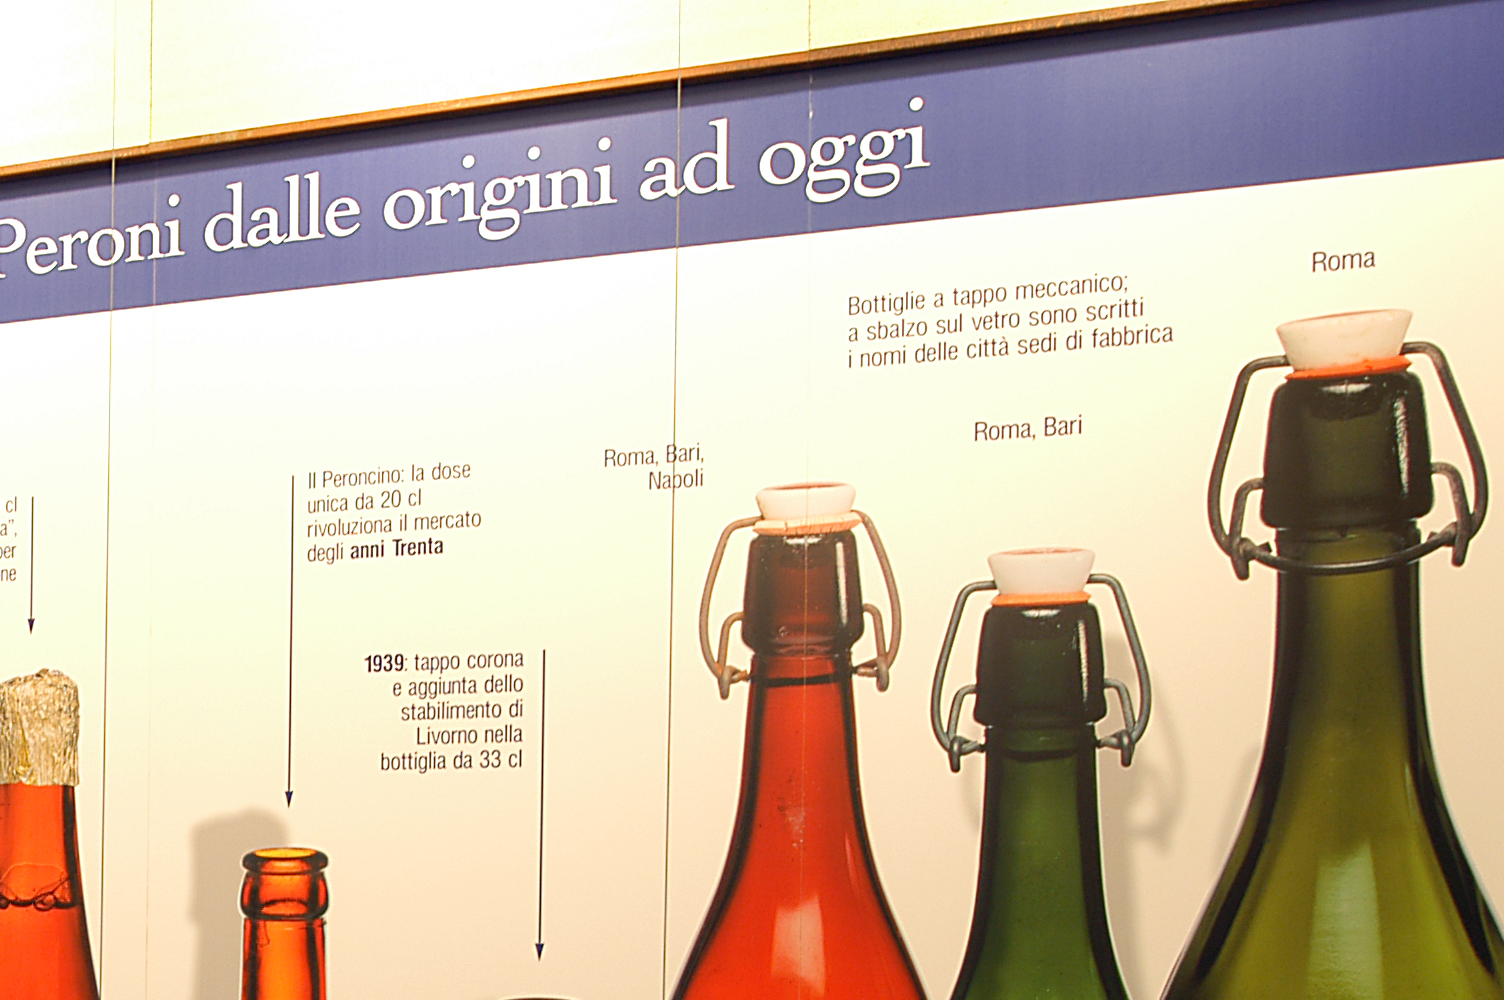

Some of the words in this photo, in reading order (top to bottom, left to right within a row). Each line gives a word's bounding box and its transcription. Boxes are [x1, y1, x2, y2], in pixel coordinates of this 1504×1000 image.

[204, 174, 361, 253] dalle
[383, 137, 617, 240] origini
[640, 118, 733, 200] ad
[759, 97, 930, 203] oggi
[1311, 251, 1376, 273] Roma
[847, 291, 926, 317] Bottiglie
[933, 291, 945, 308] a
[952, 285, 1008, 312] tappo
[1015, 273, 1129, 301] meccanico;
[848, 326, 859, 344] a
[866, 317, 928, 342] sbalzo
[936, 313, 963, 336] sul
[971, 310, 1021, 333] vetro
[1028, 307, 1078, 327] sono
[1085, 297, 1145, 322] scritti
[847, 349, 853, 369] i
[860, 346, 907, 369] nomi
[914, 341, 958, 364] delle
[966, 335, 1010, 360] città
[1017, 332, 1058, 355] sedi
[1065, 331, 1084, 351] di
[1090, 323, 1174, 350] fabbrica
[974, 420, 1036, 442] Roma,
[1044, 414, 1083, 438] Bari
[603, 448, 658, 468] Roma,
[666, 443, 705, 465] Bari,
[308, 471, 317, 490] Il
[322, 466, 405, 488] Peroncino:
[411, 463, 426, 483] la
[431, 462, 471, 480] dose
[648, 468, 704, 491] Napoli
[5, 496, 17, 513] cl
[307, 495, 349, 514] unica
[354, 492, 374, 511] da
[380, 489, 402, 509] 20
[408, 488, 422, 507] cl
[307, 516, 392, 538] rivoluziona
[399, 514, 408, 532] il
[414, 510, 482, 531] mercato
[307, 542, 344, 565] degli
[350, 540, 385, 560] anni
[392, 537, 444, 556] Trenta
[364, 653, 408, 673] 1939:
[414, 653, 461, 674] tappo
[467, 651, 524, 669] corona
[393, 683, 402, 697] e
[408, 677, 477, 700] aggiunta
[484, 674, 524, 694] dello
[401, 701, 502, 722] stabilimento
[508, 699, 524, 718] di
[416, 726, 478, 746] Livorno
[484, 724, 523, 743] nella
[380, 752, 447, 774] bottiglia
[452, 751, 473, 770] da
[479, 750, 502, 769] 33
[508, 748, 523, 769] cl
